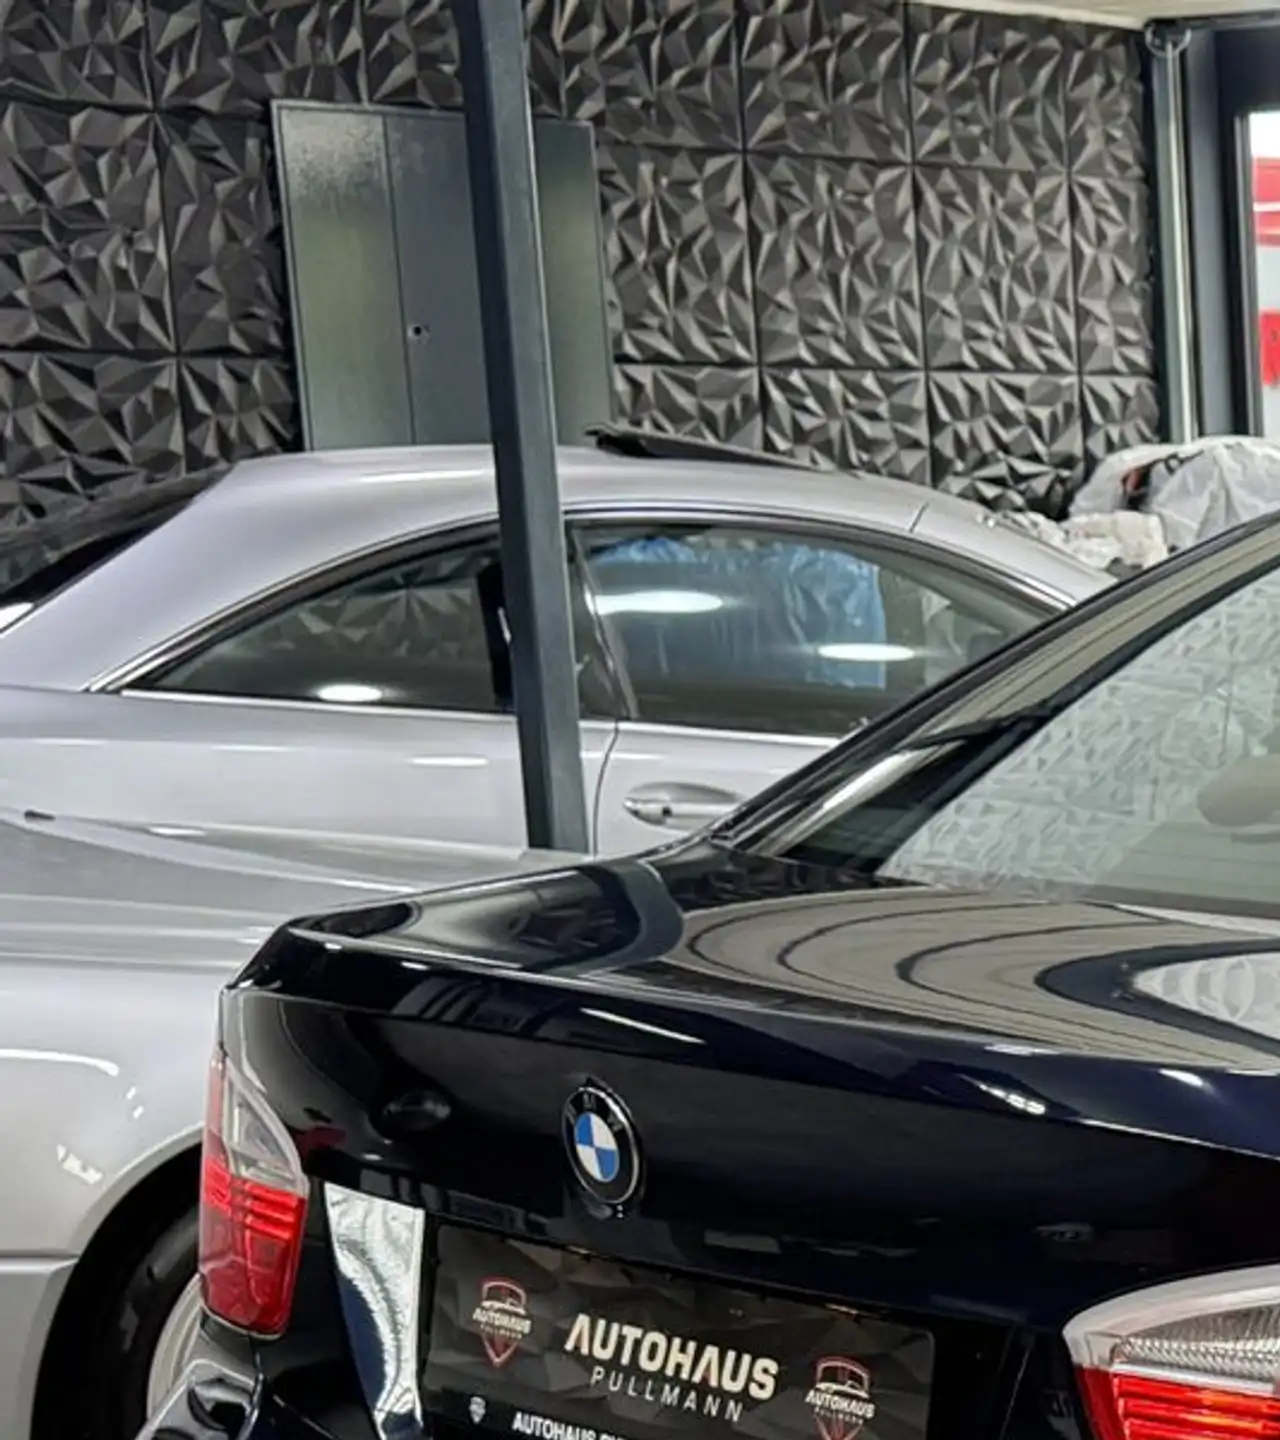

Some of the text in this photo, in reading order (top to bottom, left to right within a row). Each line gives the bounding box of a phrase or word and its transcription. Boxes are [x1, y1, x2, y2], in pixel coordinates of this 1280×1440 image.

[564, 1312, 780, 1400] AUTOHAUS
[589, 1365, 744, 1422] PULLMANN
[804, 1389, 875, 1419] AUTOHAUS
